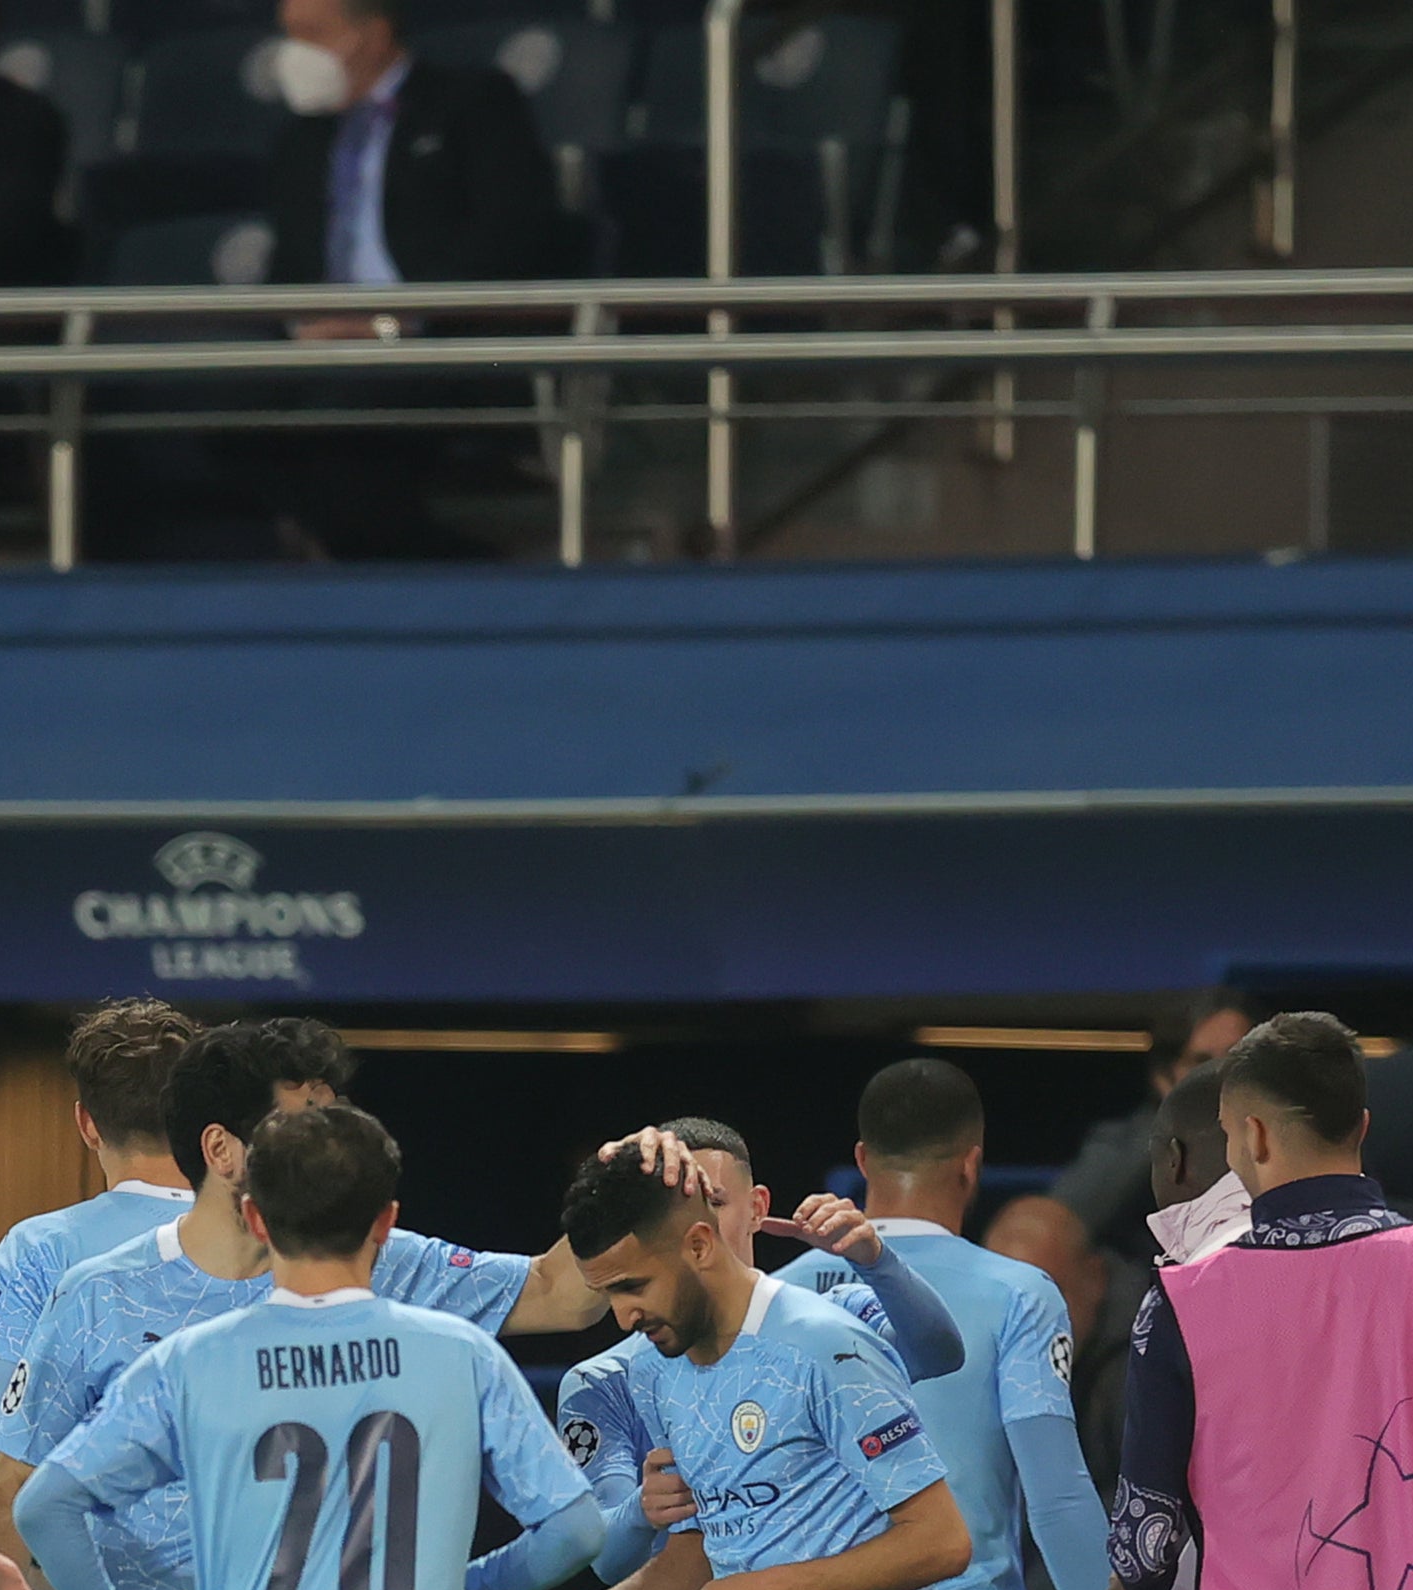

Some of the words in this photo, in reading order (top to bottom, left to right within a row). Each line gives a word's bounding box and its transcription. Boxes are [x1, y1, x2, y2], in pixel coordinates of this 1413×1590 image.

[74, 890, 365, 939] CHAMPIONS
[150, 940, 298, 980] LEAGUE
[256, 1338, 401, 1390] BERNARDO
